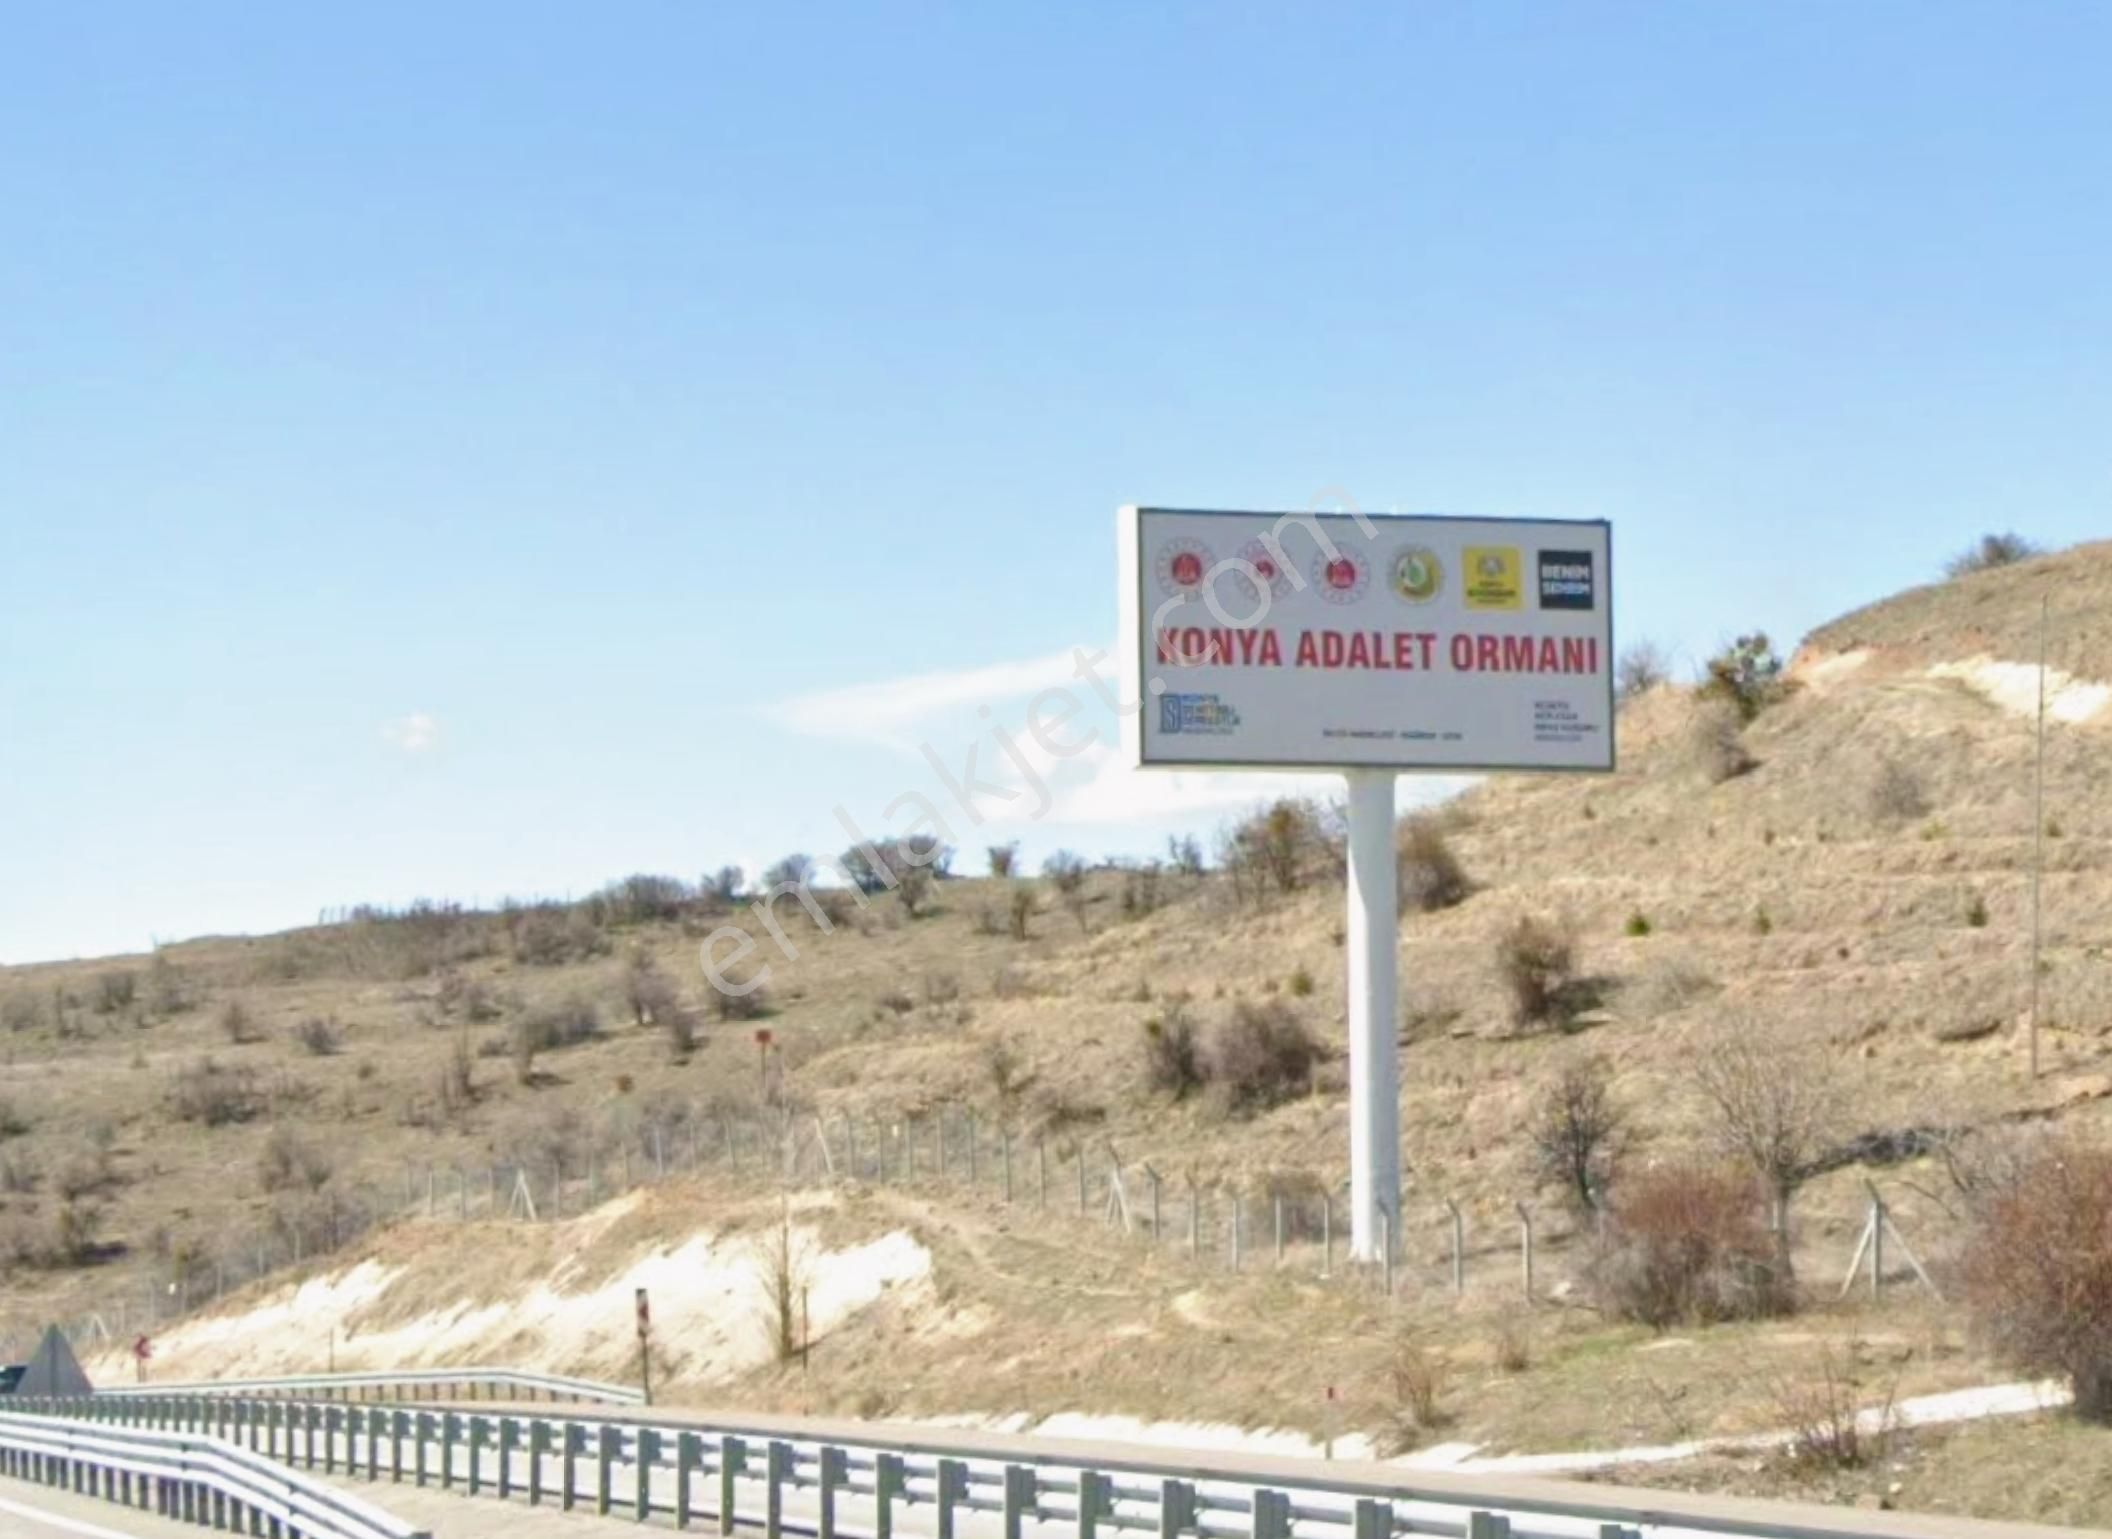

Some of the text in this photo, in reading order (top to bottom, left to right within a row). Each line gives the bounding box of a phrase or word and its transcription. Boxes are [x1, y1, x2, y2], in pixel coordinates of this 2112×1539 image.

[1156, 626, 1598, 675] KONYA ADALET ORMANI
